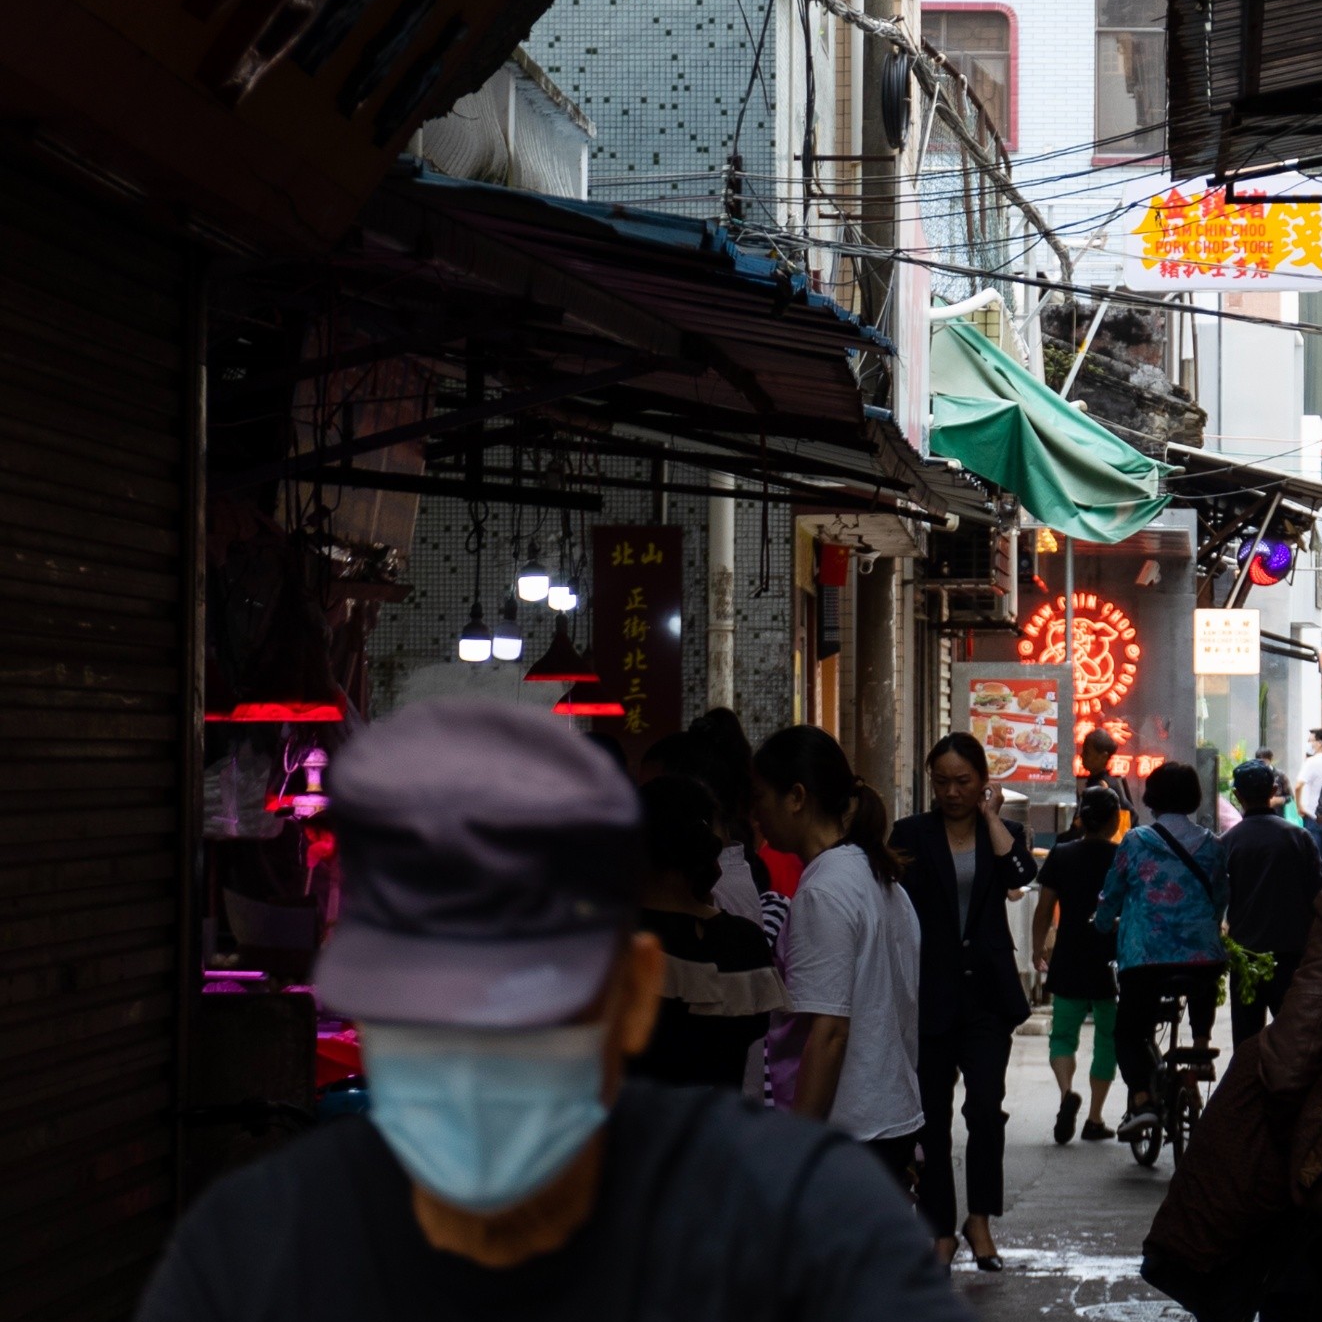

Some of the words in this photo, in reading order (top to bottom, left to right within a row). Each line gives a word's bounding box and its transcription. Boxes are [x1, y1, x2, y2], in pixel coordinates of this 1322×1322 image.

[1163, 224, 1191, 237] KAM
[1195, 224, 1227, 237] CHIN
[1231, 224, 1266, 237] CHOO
[1155, 240, 1190, 254] PORK
[1194, 240, 1229, 254] CHOP
[1234, 240, 1273, 254] STORE
[610, 541, 664, 567] 北山
[1025, 603, 1053, 637] KAM
